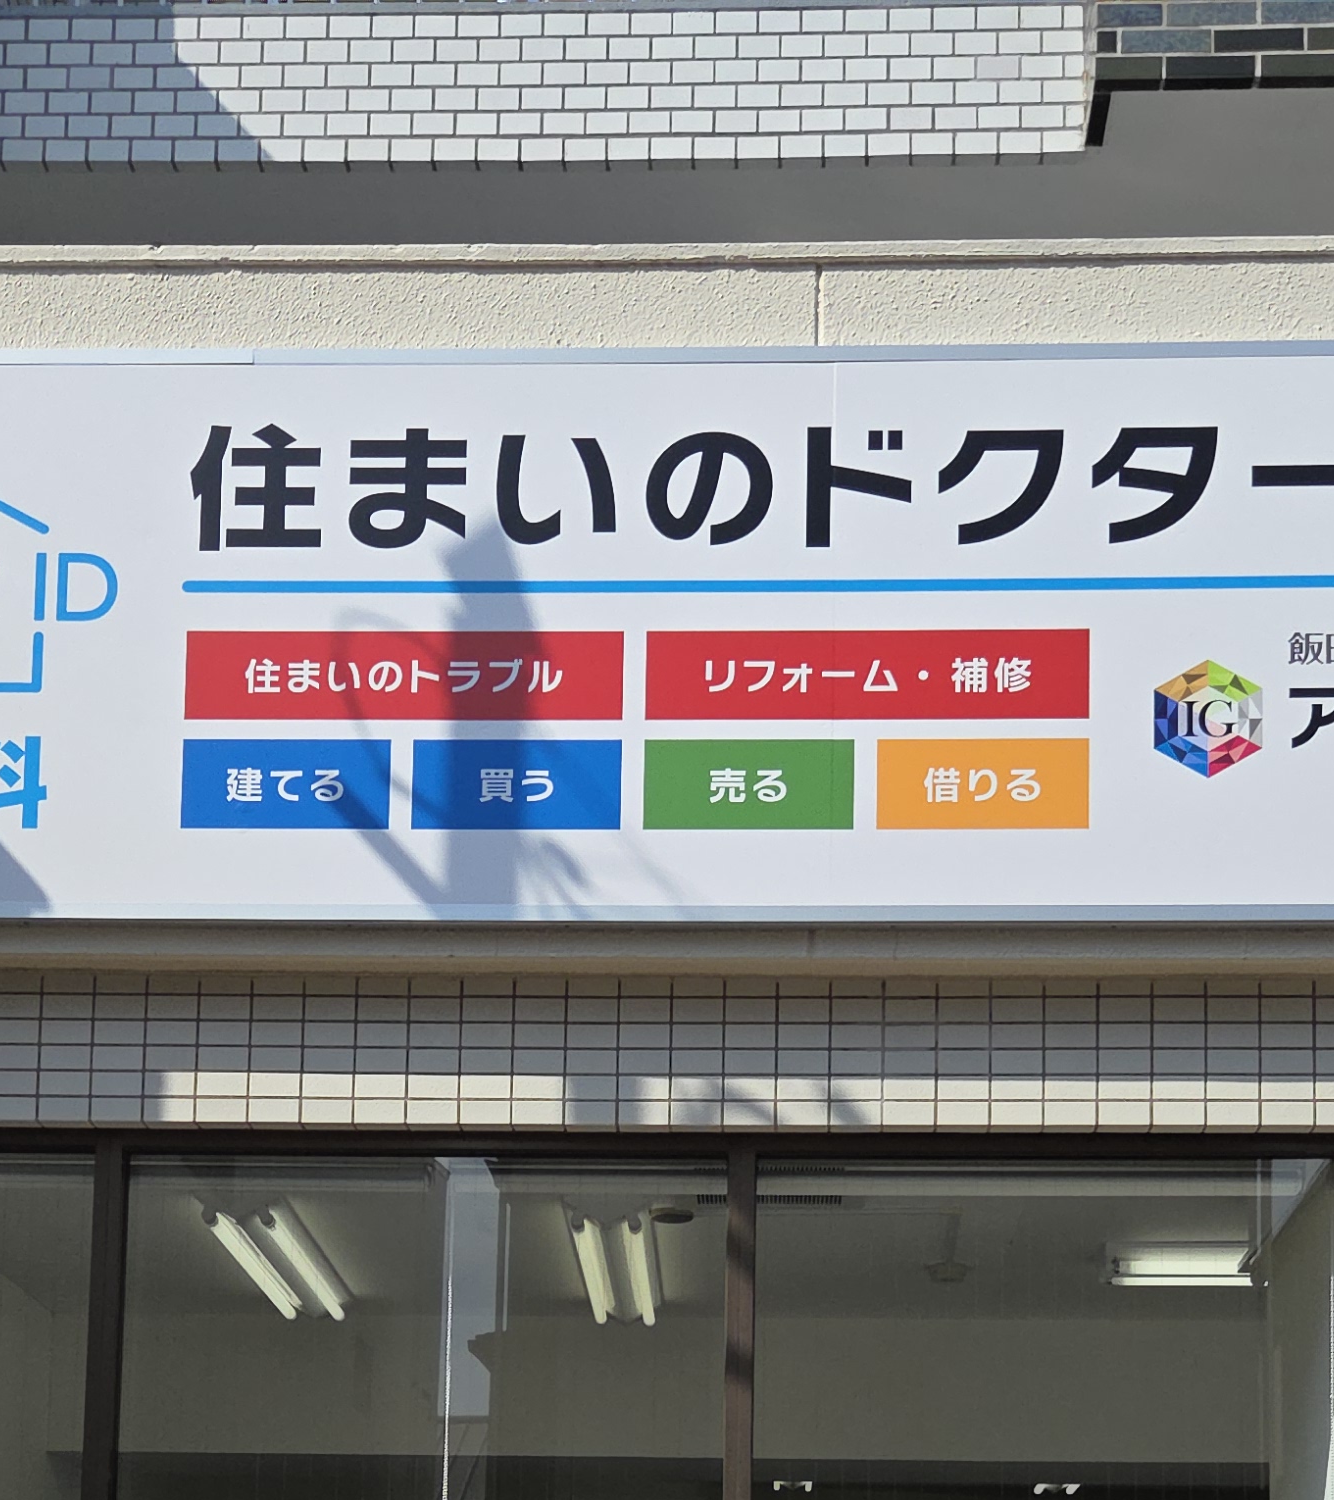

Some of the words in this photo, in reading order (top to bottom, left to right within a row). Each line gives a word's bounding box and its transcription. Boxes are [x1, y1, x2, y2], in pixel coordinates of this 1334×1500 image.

[33, 552, 119, 622] ID
[244, 657, 564, 694] 住まいのトラブル
[702, 655, 1034, 695] リフォーム・補修
[1182, 699, 1236, 739] IG
[225, 767, 346, 804] 建てる
[478, 767, 556, 803] 買う
[707, 766, 789, 804] 売る
[922, 766, 1043, 804] 借りる
